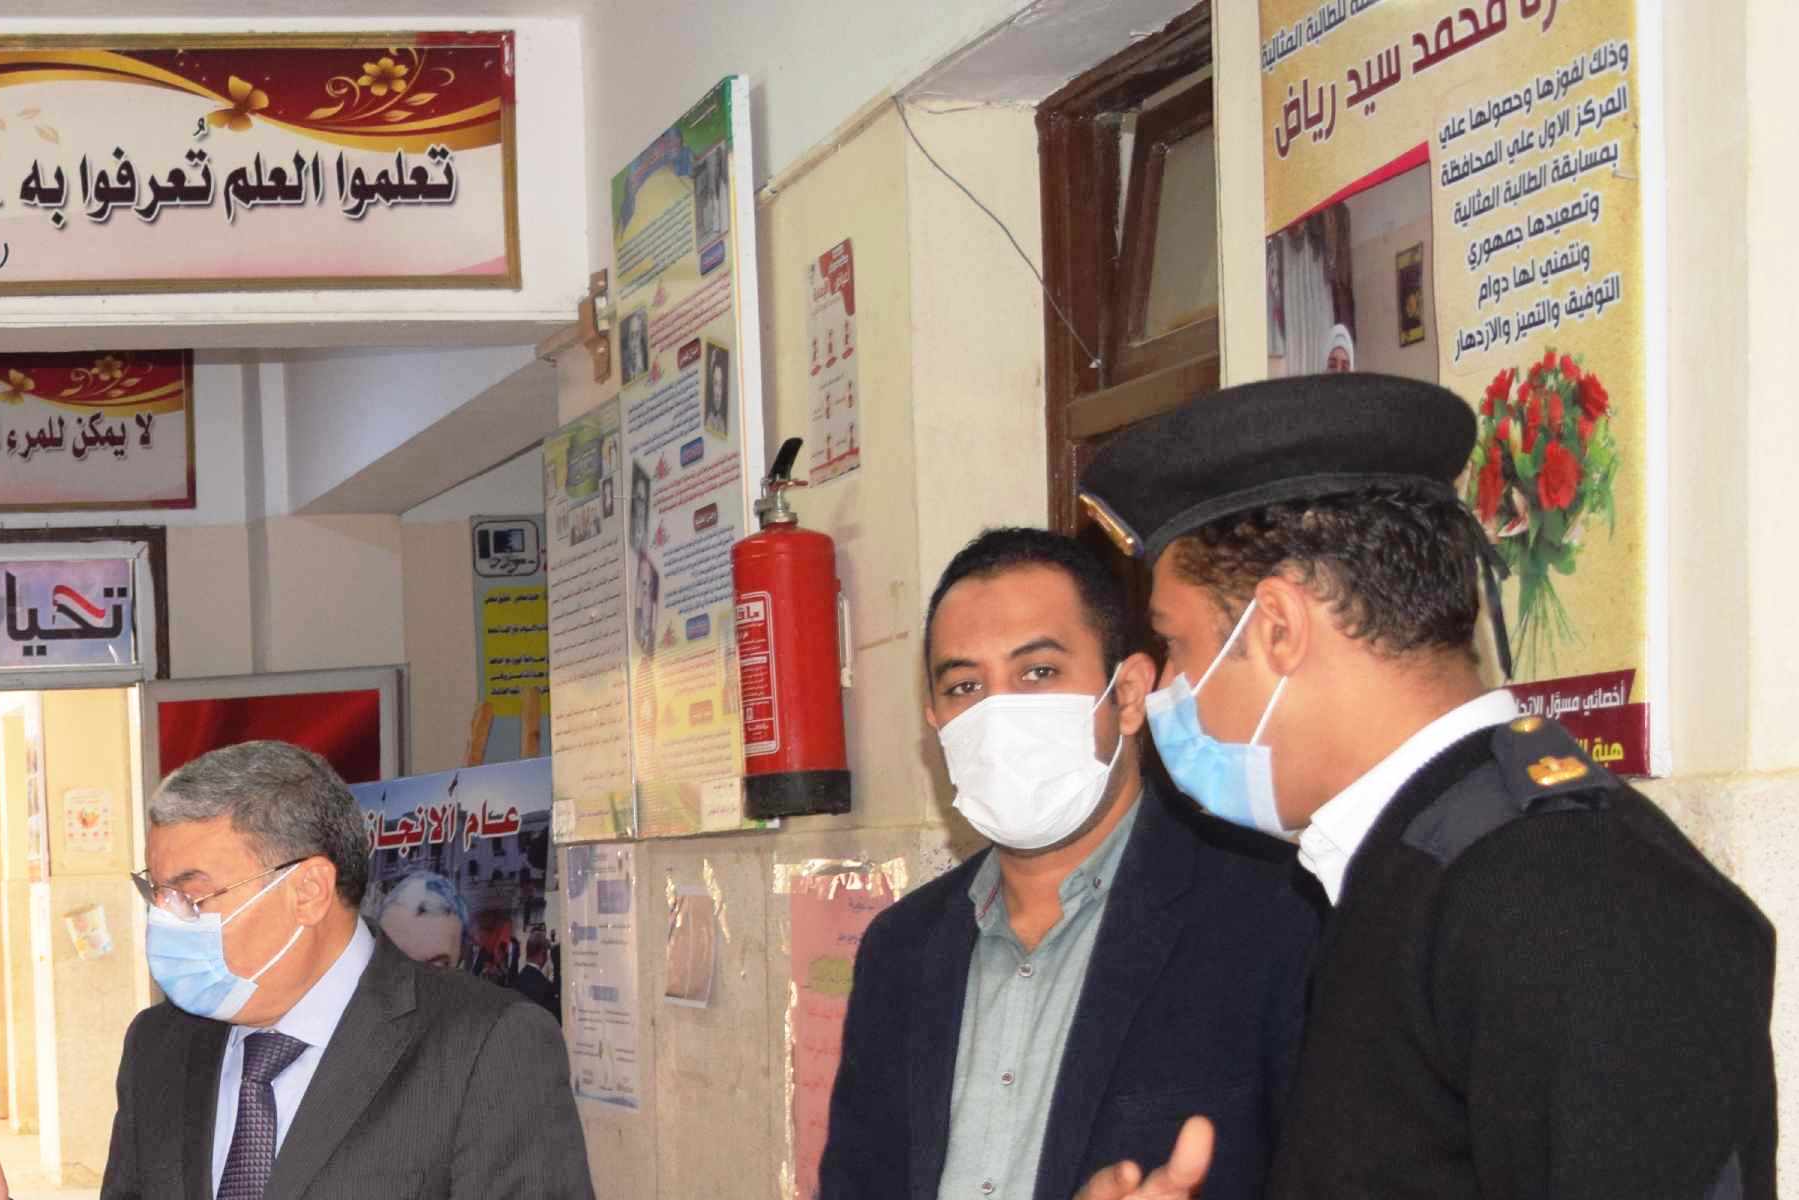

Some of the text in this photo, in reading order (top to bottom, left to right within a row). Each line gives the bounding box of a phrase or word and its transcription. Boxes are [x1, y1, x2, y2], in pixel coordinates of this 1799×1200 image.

[1413, 0, 1507, 74] محمد
[1275, 79, 1336, 158] رياض
[1347, 44, 1401, 117] سيد
[1439, 42, 1630, 148] وذلك لفوزها وحصولها علي
[1441, 86, 1628, 187] المركز الاول علي المحافظة
[18, 152, 68, 229] به
[224, 150, 324, 223] العلم
[336, 143, 458, 221] تعلموا
[1453, 143, 1619, 228] بمسابقة الطالبة المثالية
[1466, 192, 1601, 270] وتصعيدها جمهوري
[1477, 241, 1591, 309] ونتمني لها دوام
[1454, 276, 1620, 361] التوفيق والتميز والازدهار
[6, 415, 65, 459] للمرء
[70, 412, 128, 460] يمكن
[134, 412, 154, 448] لا
[3, 570, 129, 658] تحيا
[463, 799, 521, 852] عام
